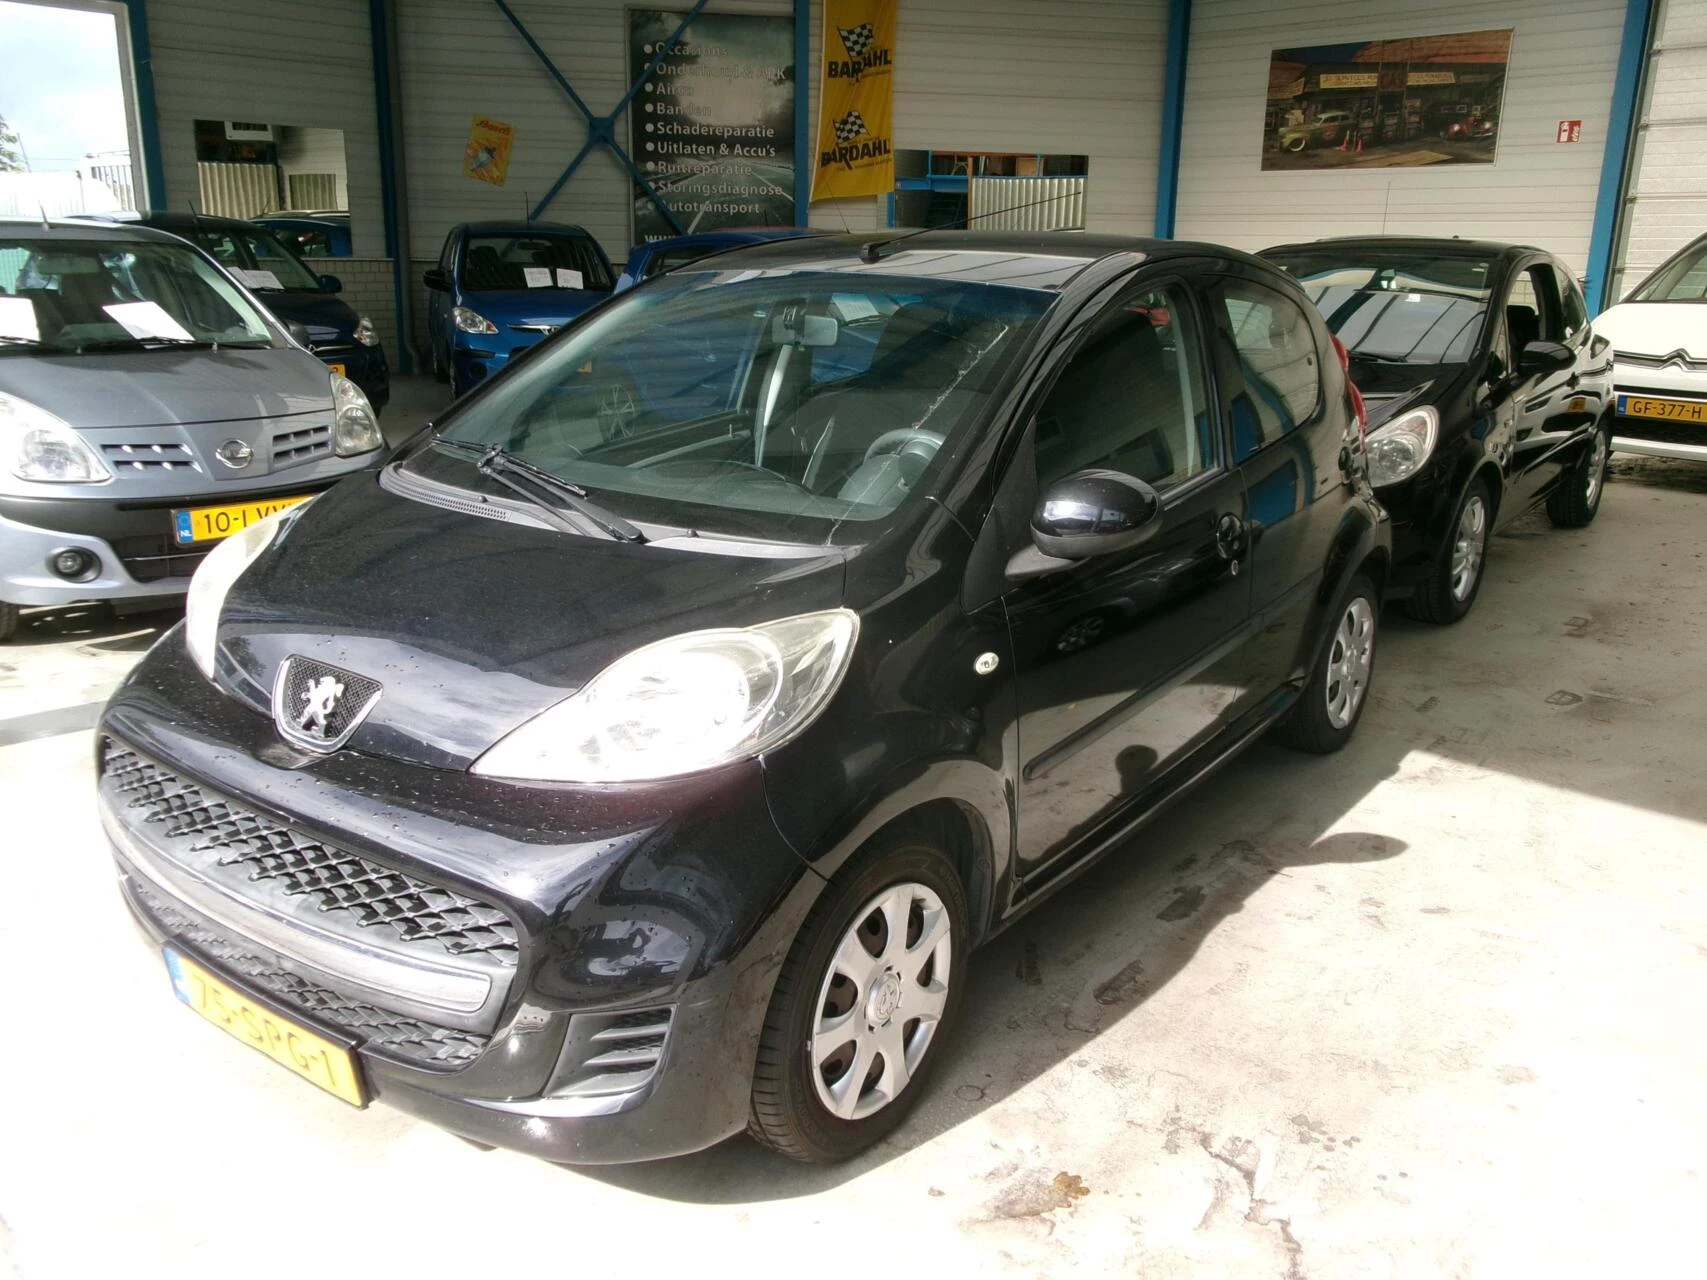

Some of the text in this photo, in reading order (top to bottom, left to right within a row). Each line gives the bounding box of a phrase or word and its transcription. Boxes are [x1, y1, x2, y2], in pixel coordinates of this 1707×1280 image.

[828, 48, 892, 82] BARDAHL
[656, 122, 775, 139] Schadereparatie
[657, 142, 777, 157] Uitlaten & Accu's
[821, 139, 891, 170] BARDAHL
[657, 161, 752, 176] Ruitreparatie
[658, 180, 783, 196] Storingsdiagnose
[664, 201, 760, 216] utotransport
[1633, 400, 1702, 419] GF-377-H
